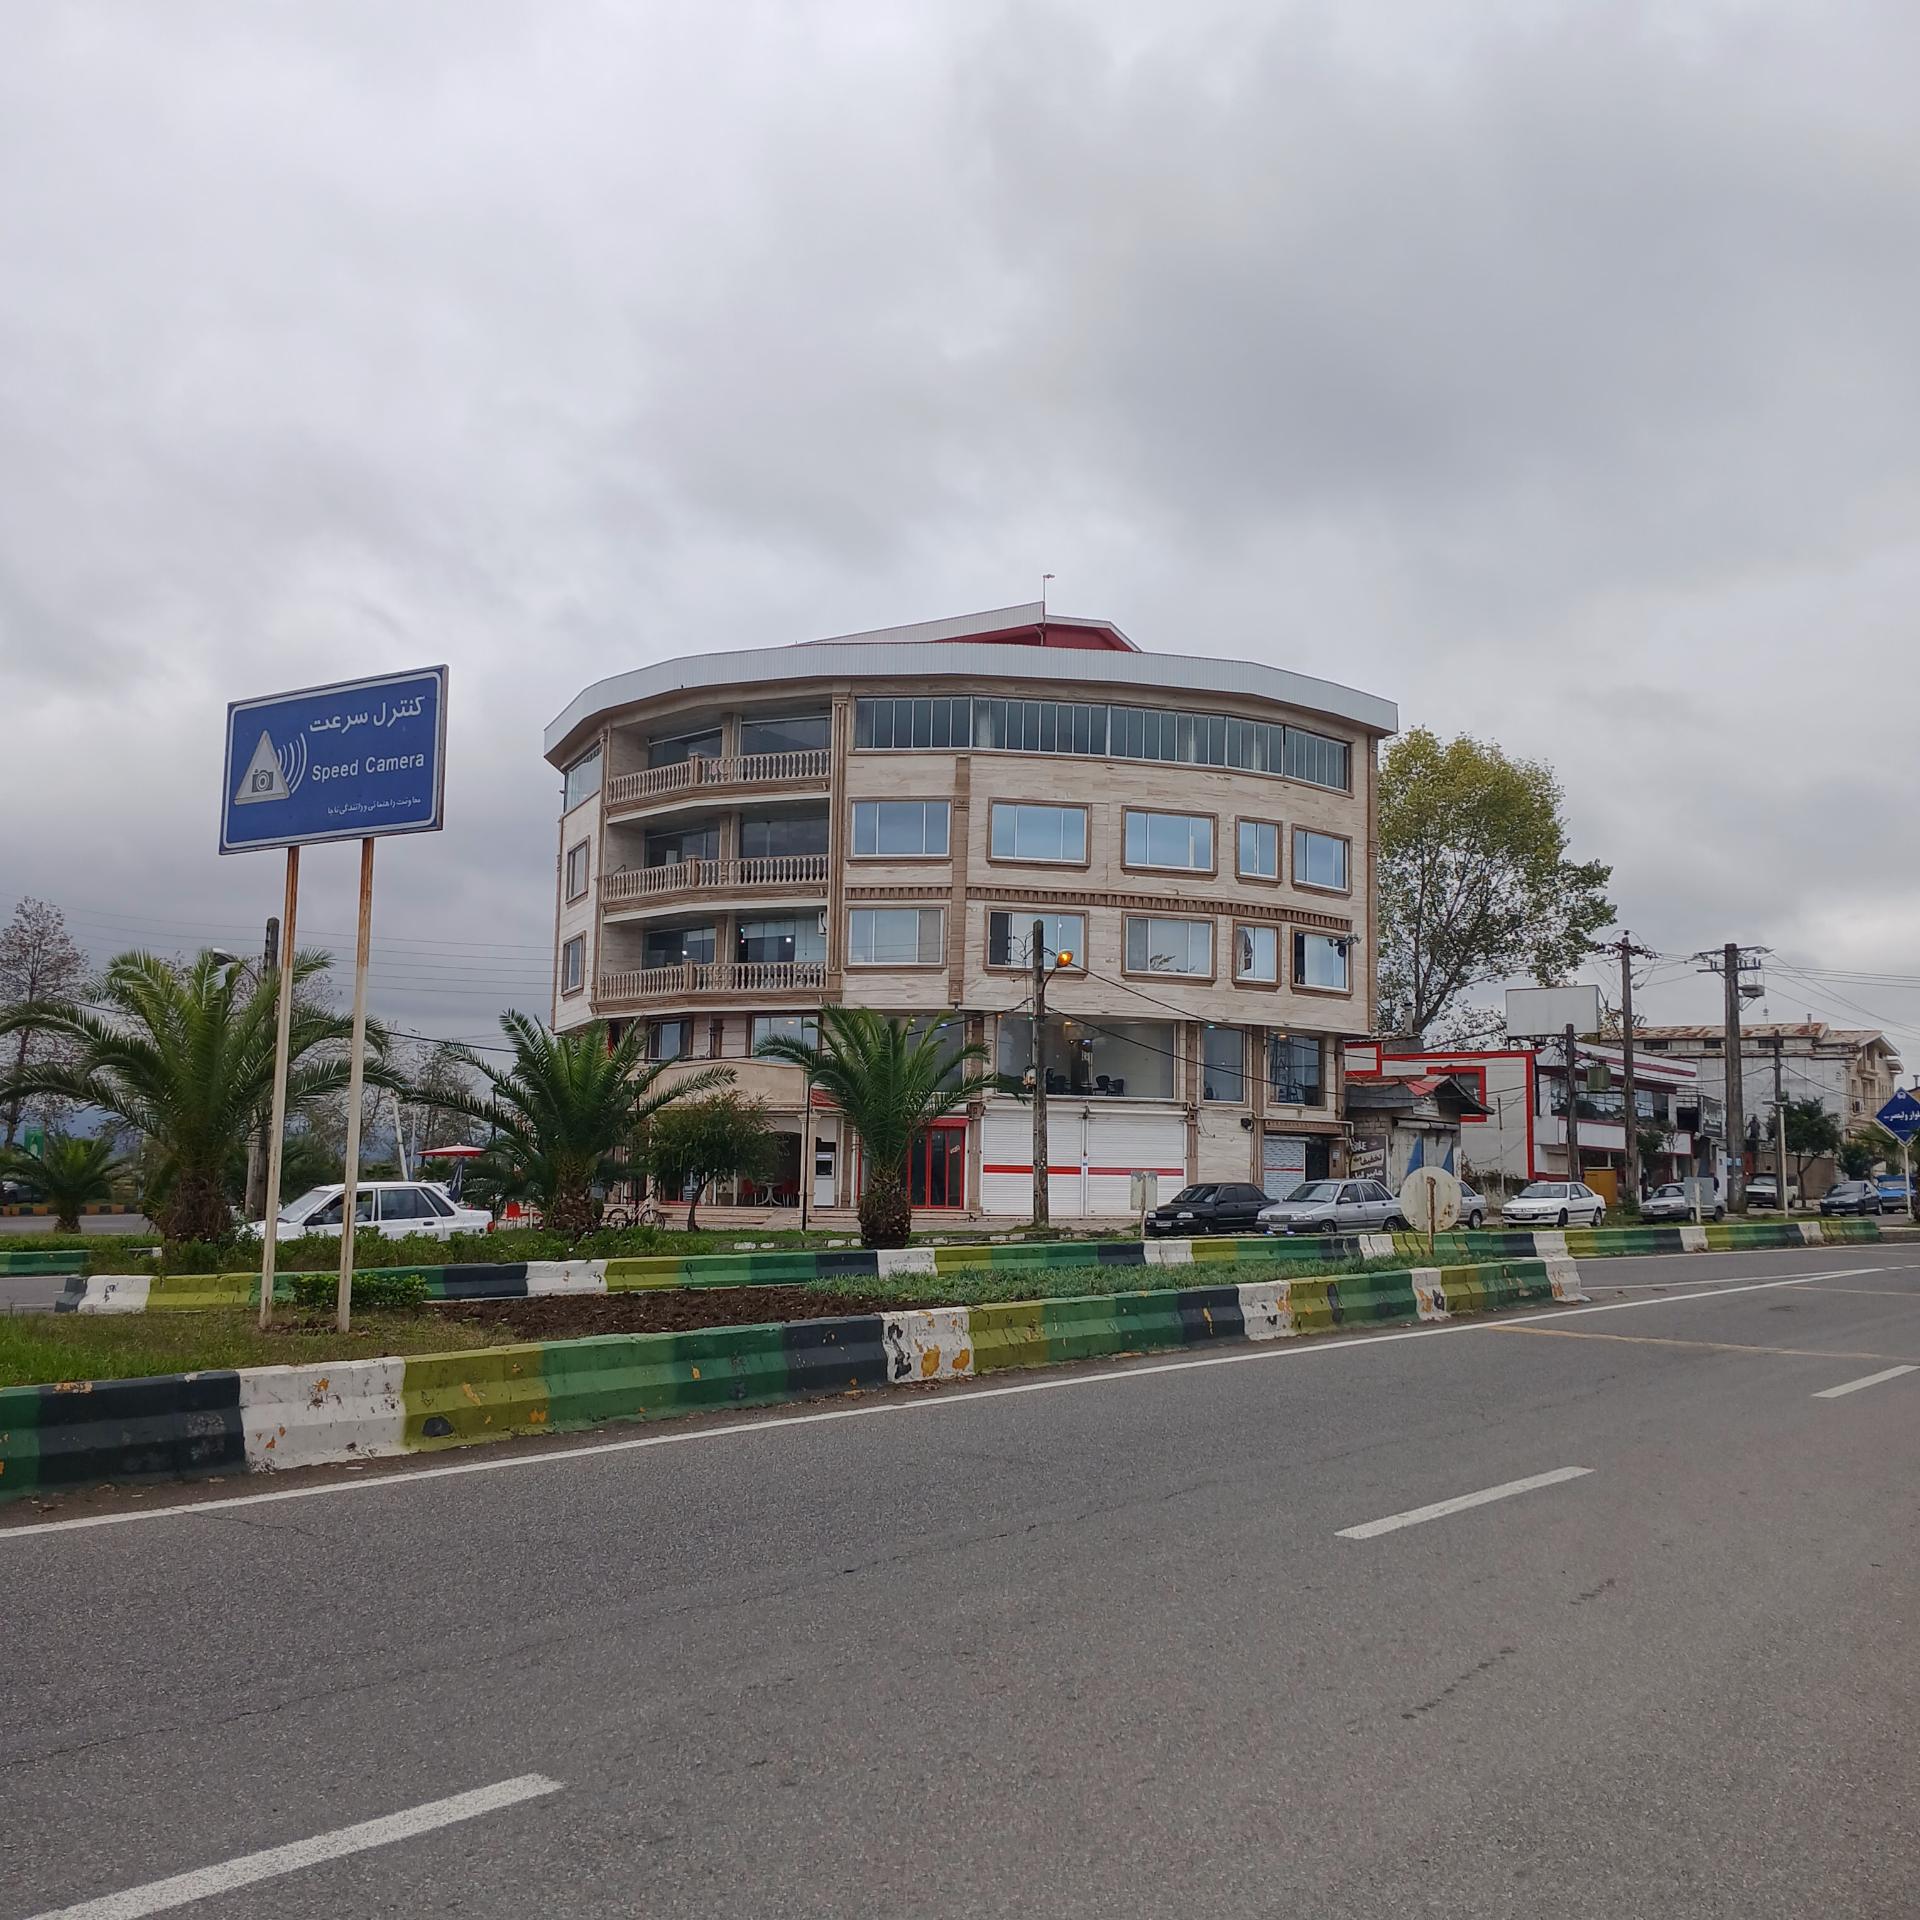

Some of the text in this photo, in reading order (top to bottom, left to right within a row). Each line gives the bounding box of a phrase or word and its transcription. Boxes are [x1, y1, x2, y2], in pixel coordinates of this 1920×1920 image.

[309, 695, 425, 734] کنترل سرعت
[311, 753, 424, 783] Speed Camera
[396, 795, 421, 807] معاونت
[1908, 1110, 1920, 1121] لوار
